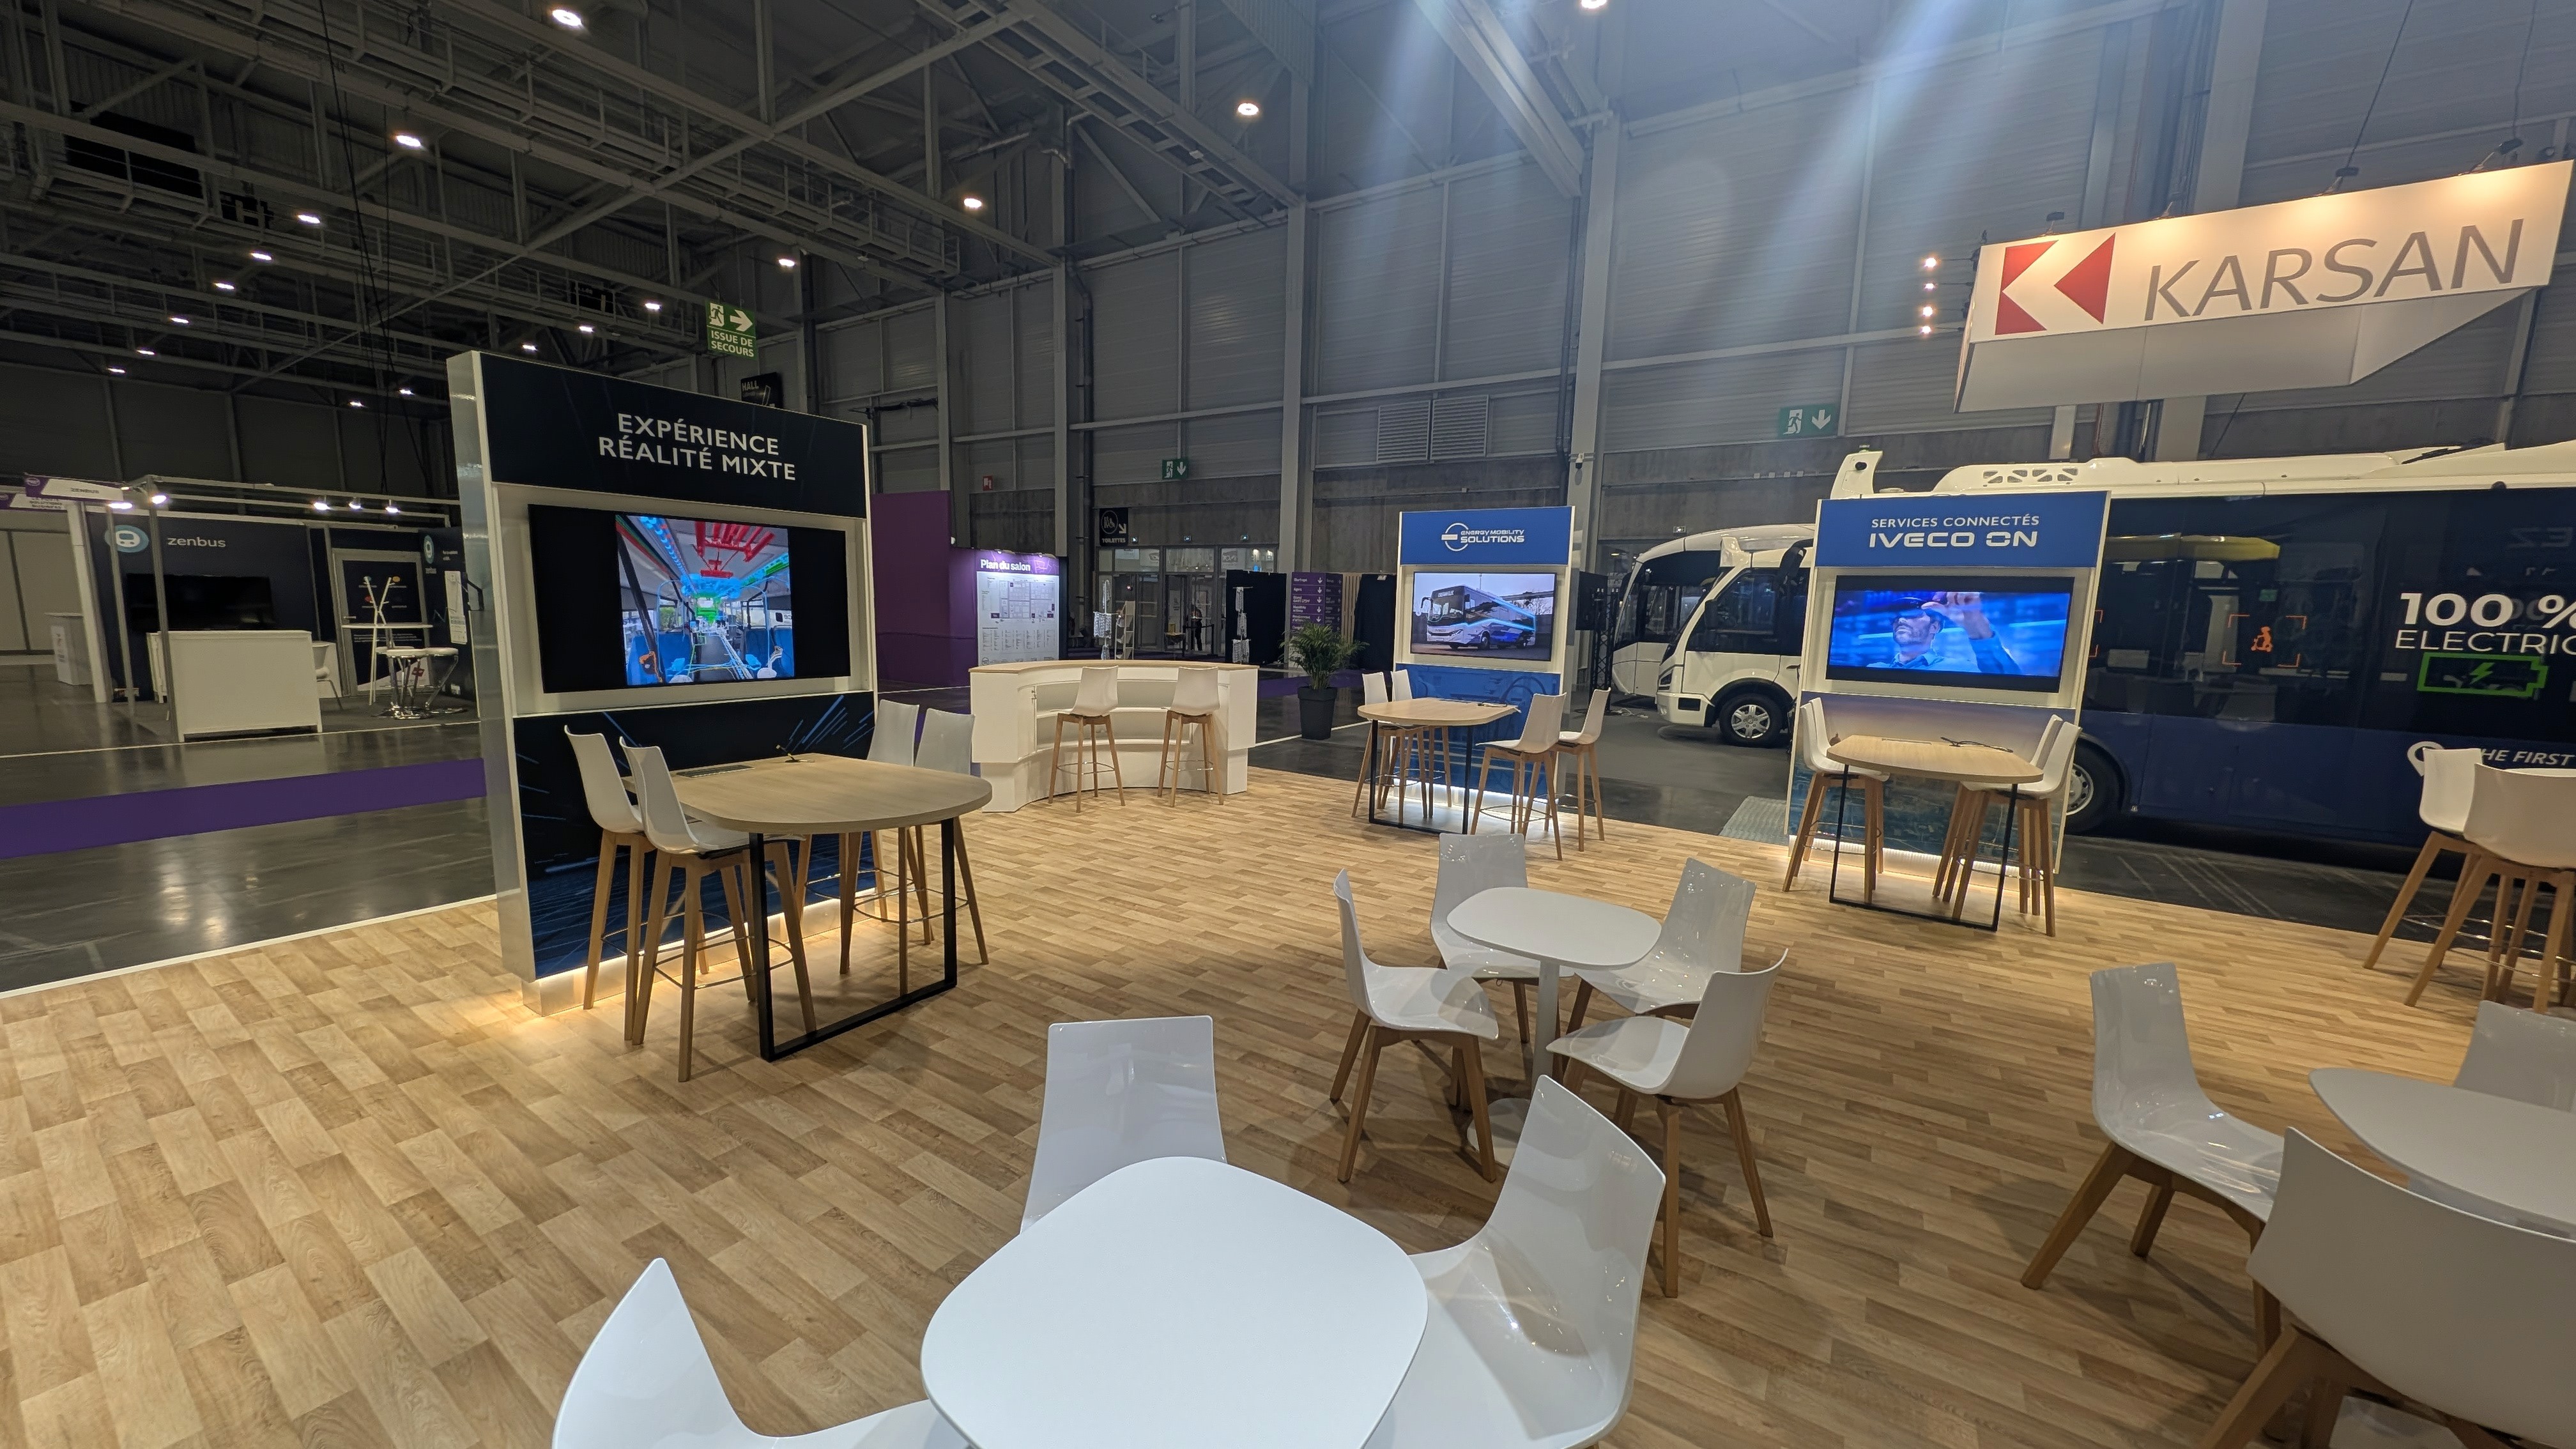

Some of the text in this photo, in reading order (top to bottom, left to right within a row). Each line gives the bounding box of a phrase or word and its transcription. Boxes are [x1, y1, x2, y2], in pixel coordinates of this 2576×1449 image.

[2144, 218, 2524, 321] KARSAN
[710, 330, 753, 348] ISSUE DE
[710, 341, 755, 357] SECOURS
[742, 380, 759, 392] HALL
[618, 413, 779, 456] EXPÉRIENCE
[599, 435, 795, 480] RÉALITÉ MIXTE
[1871, 514, 2039, 528] SERVICES CONNECTÉS
[167, 537, 226, 548] zenbus
[1869, 531, 2038, 548] IVECO ON
[981, 559, 1031, 571] Plan du salon
[2400, 593, 2515, 627] 100
[2512, 751, 2576, 767] FIRST
